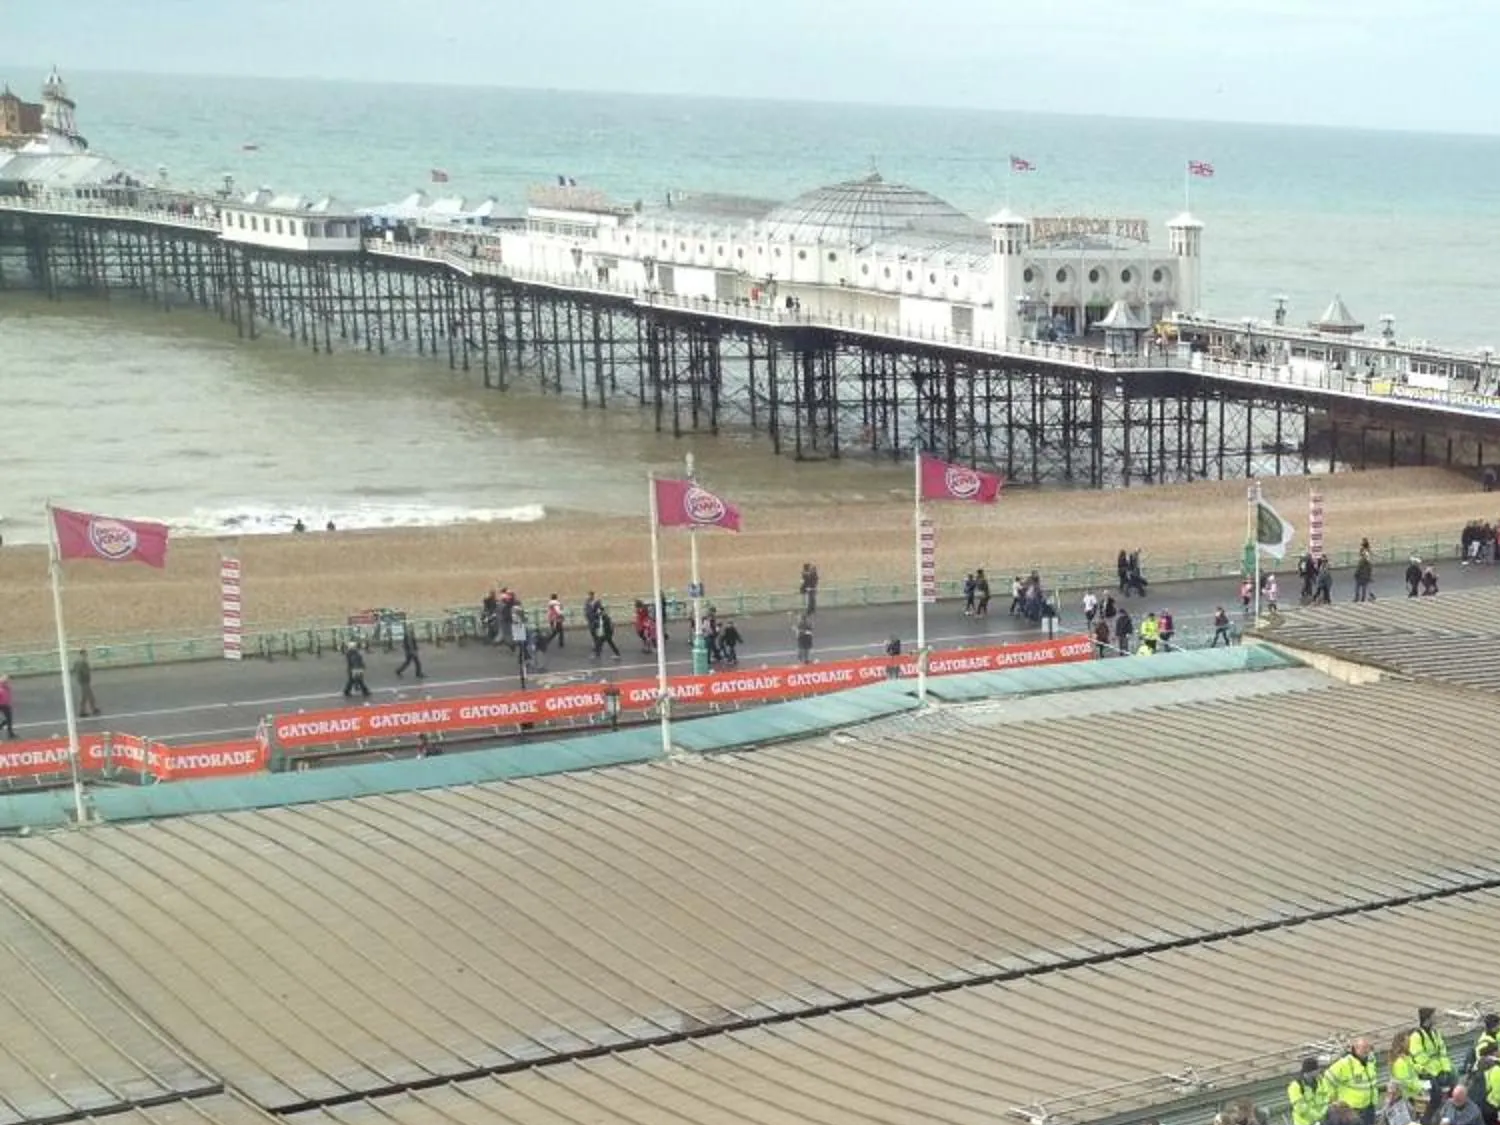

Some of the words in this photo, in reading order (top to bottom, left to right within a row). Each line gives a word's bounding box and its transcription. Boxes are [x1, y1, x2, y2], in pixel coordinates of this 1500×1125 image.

[278, 717, 361, 738] GATORADE
[370, 709, 451, 729] GATORADE
[459, 700, 538, 720] GATORADE
[711, 676, 782, 695] GATORADE
[787, 669, 853, 687] GATORADE
[929, 656, 990, 673] GATORADE
